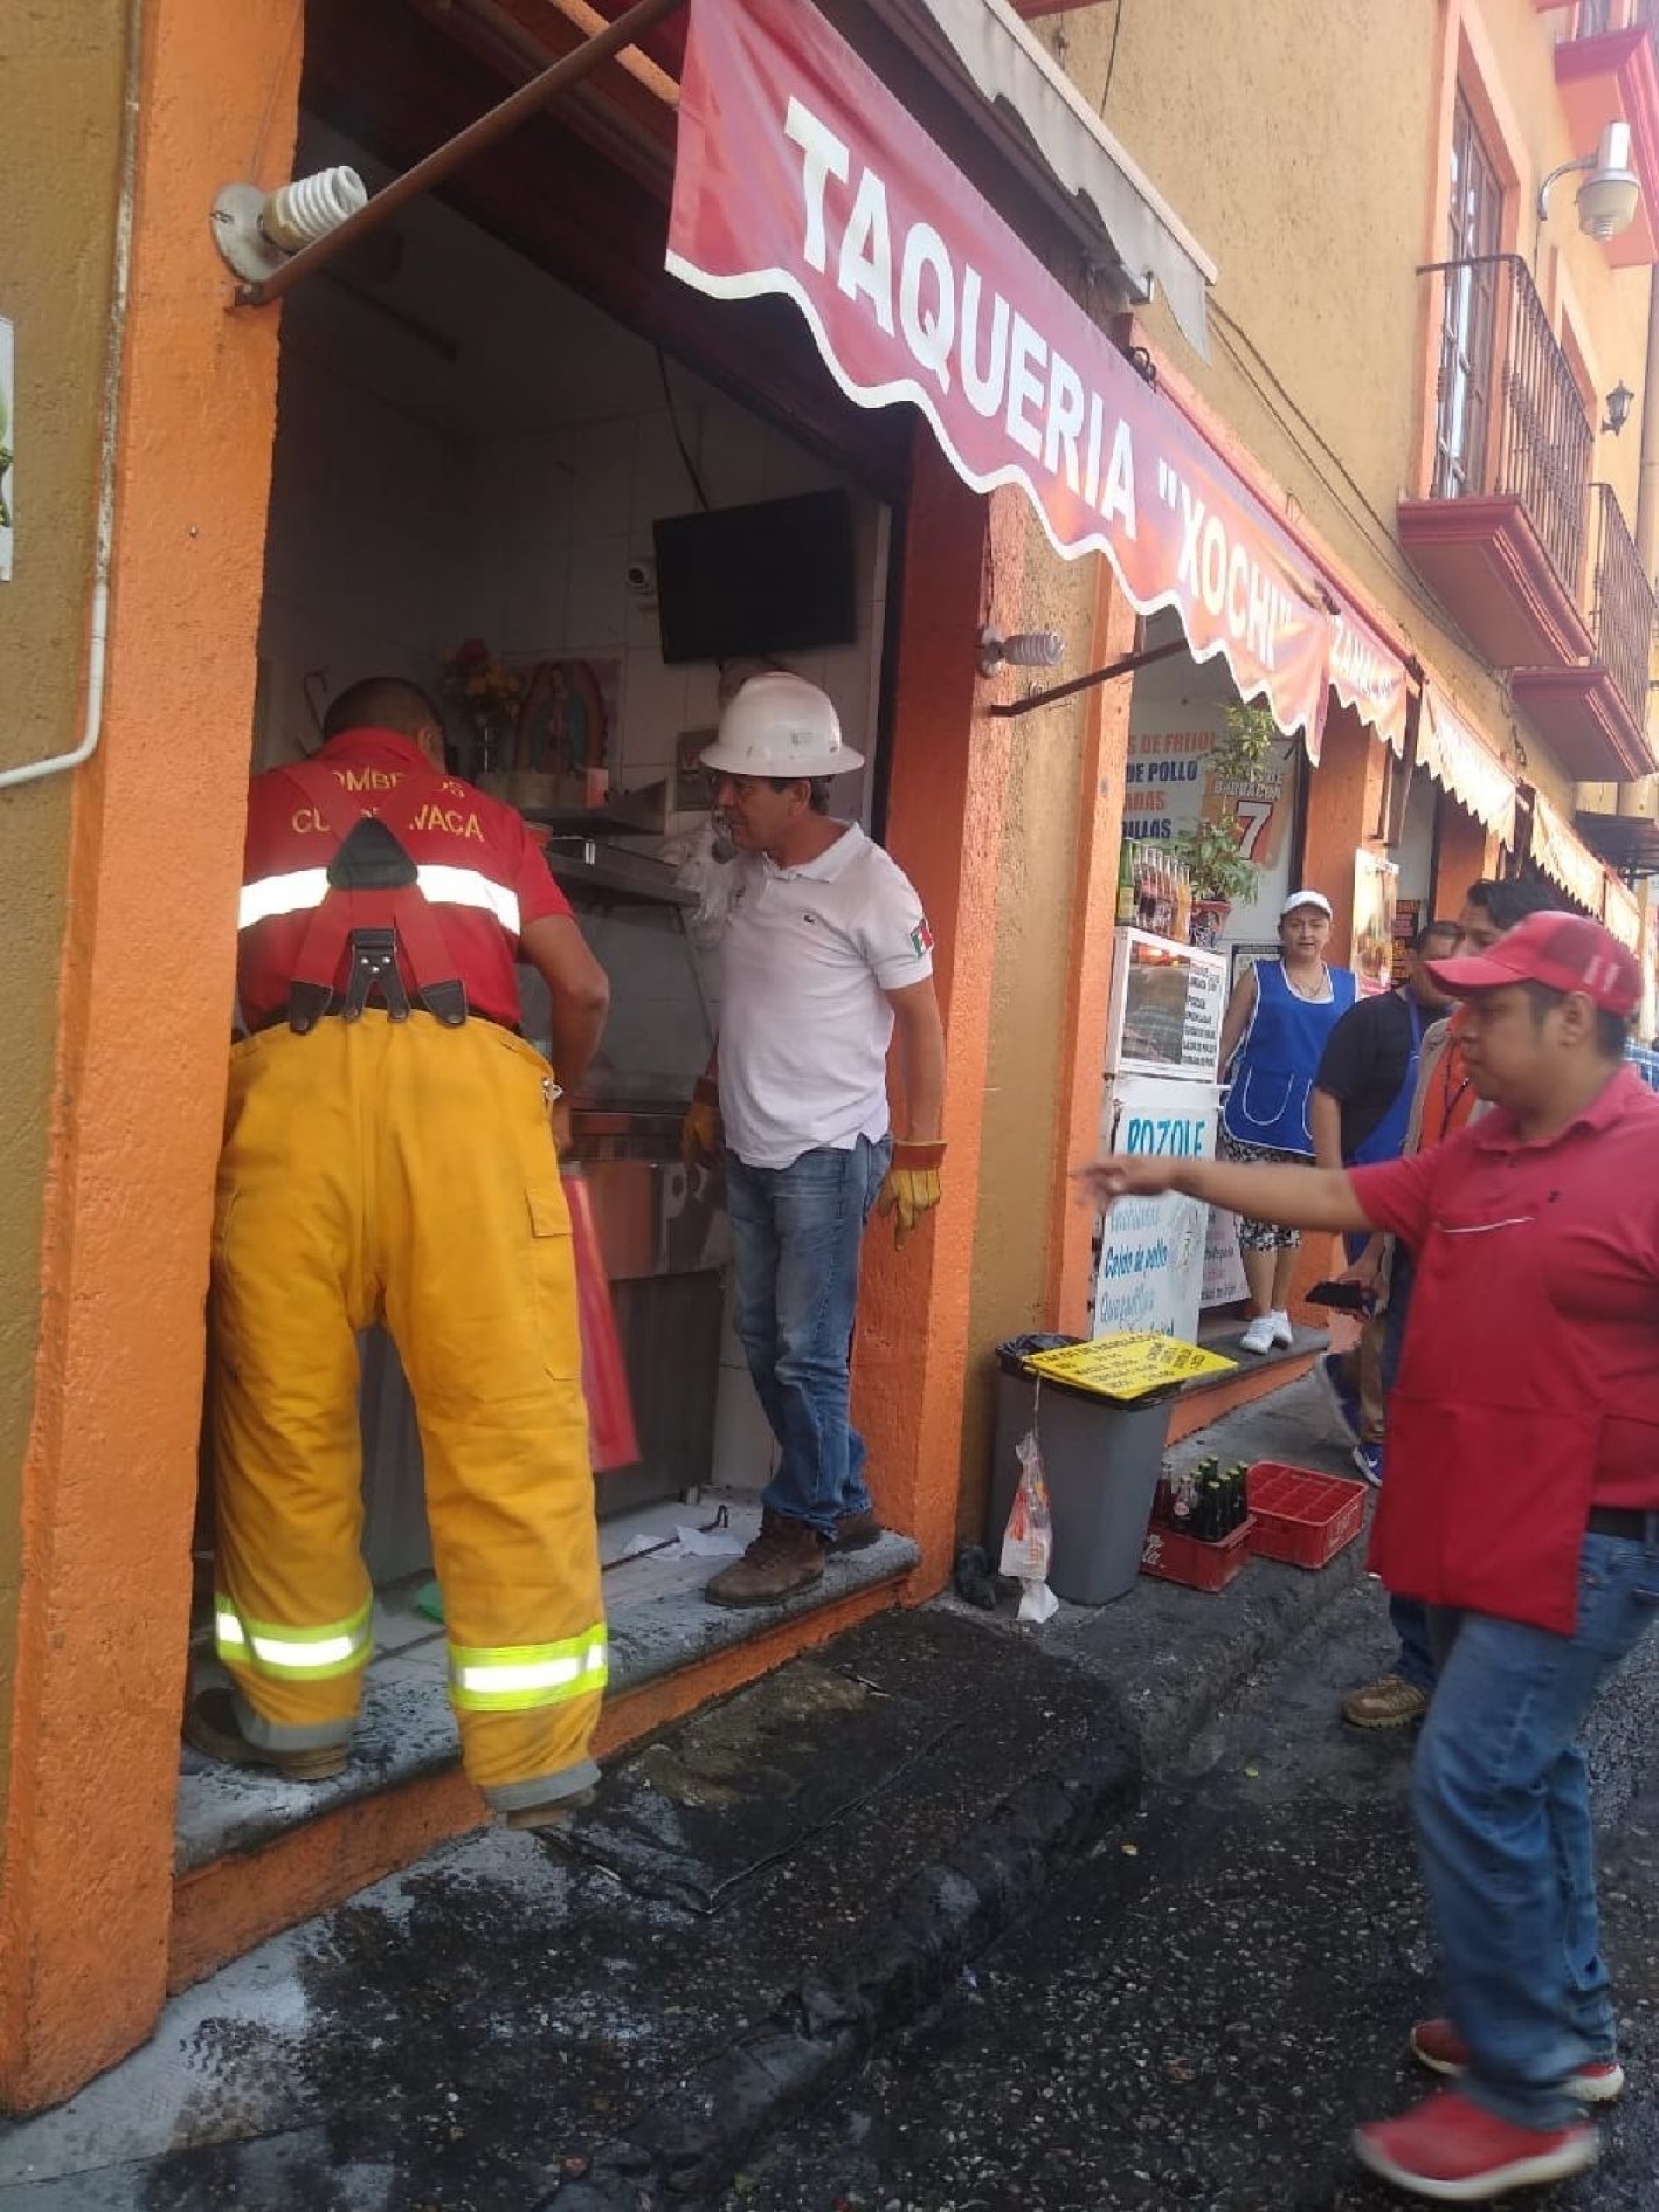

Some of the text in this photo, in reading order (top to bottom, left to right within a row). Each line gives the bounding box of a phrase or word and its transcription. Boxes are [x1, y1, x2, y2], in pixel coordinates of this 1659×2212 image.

[784, 96, 1137, 540] TAQUERIA
[1148, 760, 1198, 782] POLLO
[1236, 799, 1274, 861] 7
